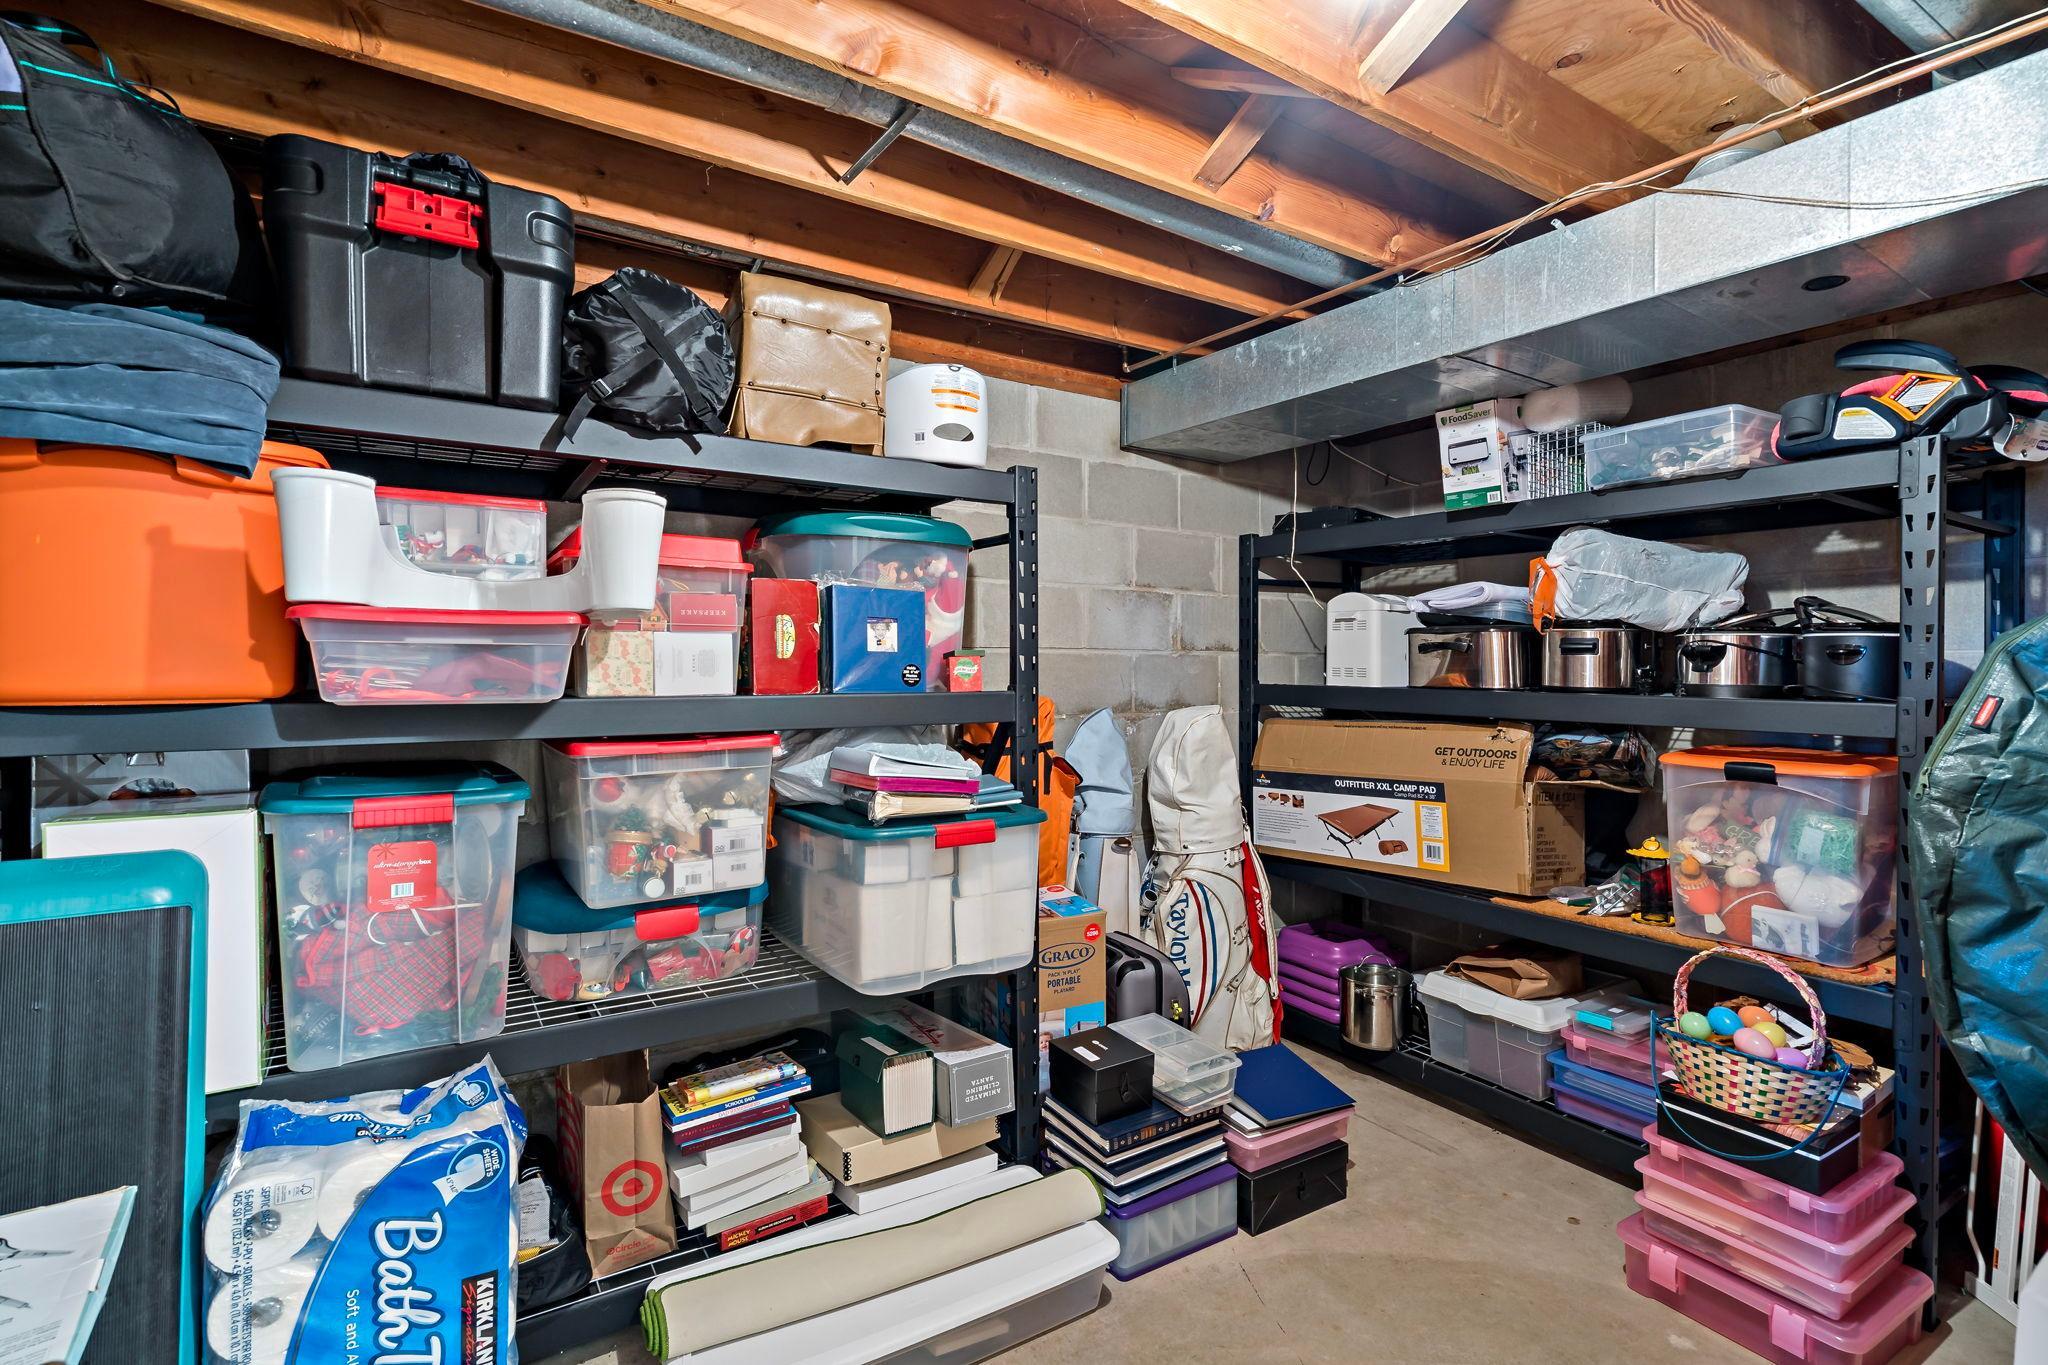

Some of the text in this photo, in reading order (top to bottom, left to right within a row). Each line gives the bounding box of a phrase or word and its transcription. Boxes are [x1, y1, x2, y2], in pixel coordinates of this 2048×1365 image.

[1448, 408, 1492, 424] FoodSaver
[1434, 746, 1517, 759] GET OUTDOORS
[1449, 758, 1482, 768] ENJOY
[1483, 759, 1505, 769] LIFE
[1334, 780, 1375, 790] OUTFITTER
[1393, 784, 1417, 793] CAMP
[1419, 786, 1437, 794] PAD
[1041, 947, 1089, 964] GRACO
[1047, 975, 1081, 988] PORTABLE
[966, 1082, 1000, 1095] CLIMBING
[971, 1076, 994, 1086] SANTA
[965, 1088, 1001, 1102] ANIMATED
[724, 1098, 744, 1109] SCHOOL
[482, 1148, 494, 1177] SHEETS
[490, 1148, 500, 1170] WIDE
[233, 1191, 243, 1206] 1425
[261, 1186, 271, 1208] SEPTIC
[233, 1208, 242, 1217] SQ
[244, 1194, 253, 1217] 6-ROLL
[233, 1218, 242, 1226] FT
[243, 1218, 253, 1237] PACKS
[232, 1228, 242, 1246] (132.3
[727, 1229, 751, 1241] MICKEY
[728, 1237, 748, 1247] MOUSE
[243, 1242, 252, 1260] 2-PLY
[243, 1266, 252, 1274] 30
[243, 1274, 252, 1296] ROLLS
[375, 1211, 443, 1349] Bath
[346, 1289, 360, 1318] Soft
[242, 1315, 252, 1339] SHEETS
[476, 1277, 494, 1365] KIRKLAN
[346, 1323, 358, 1350] and
[242, 1340, 251, 1354] PER
